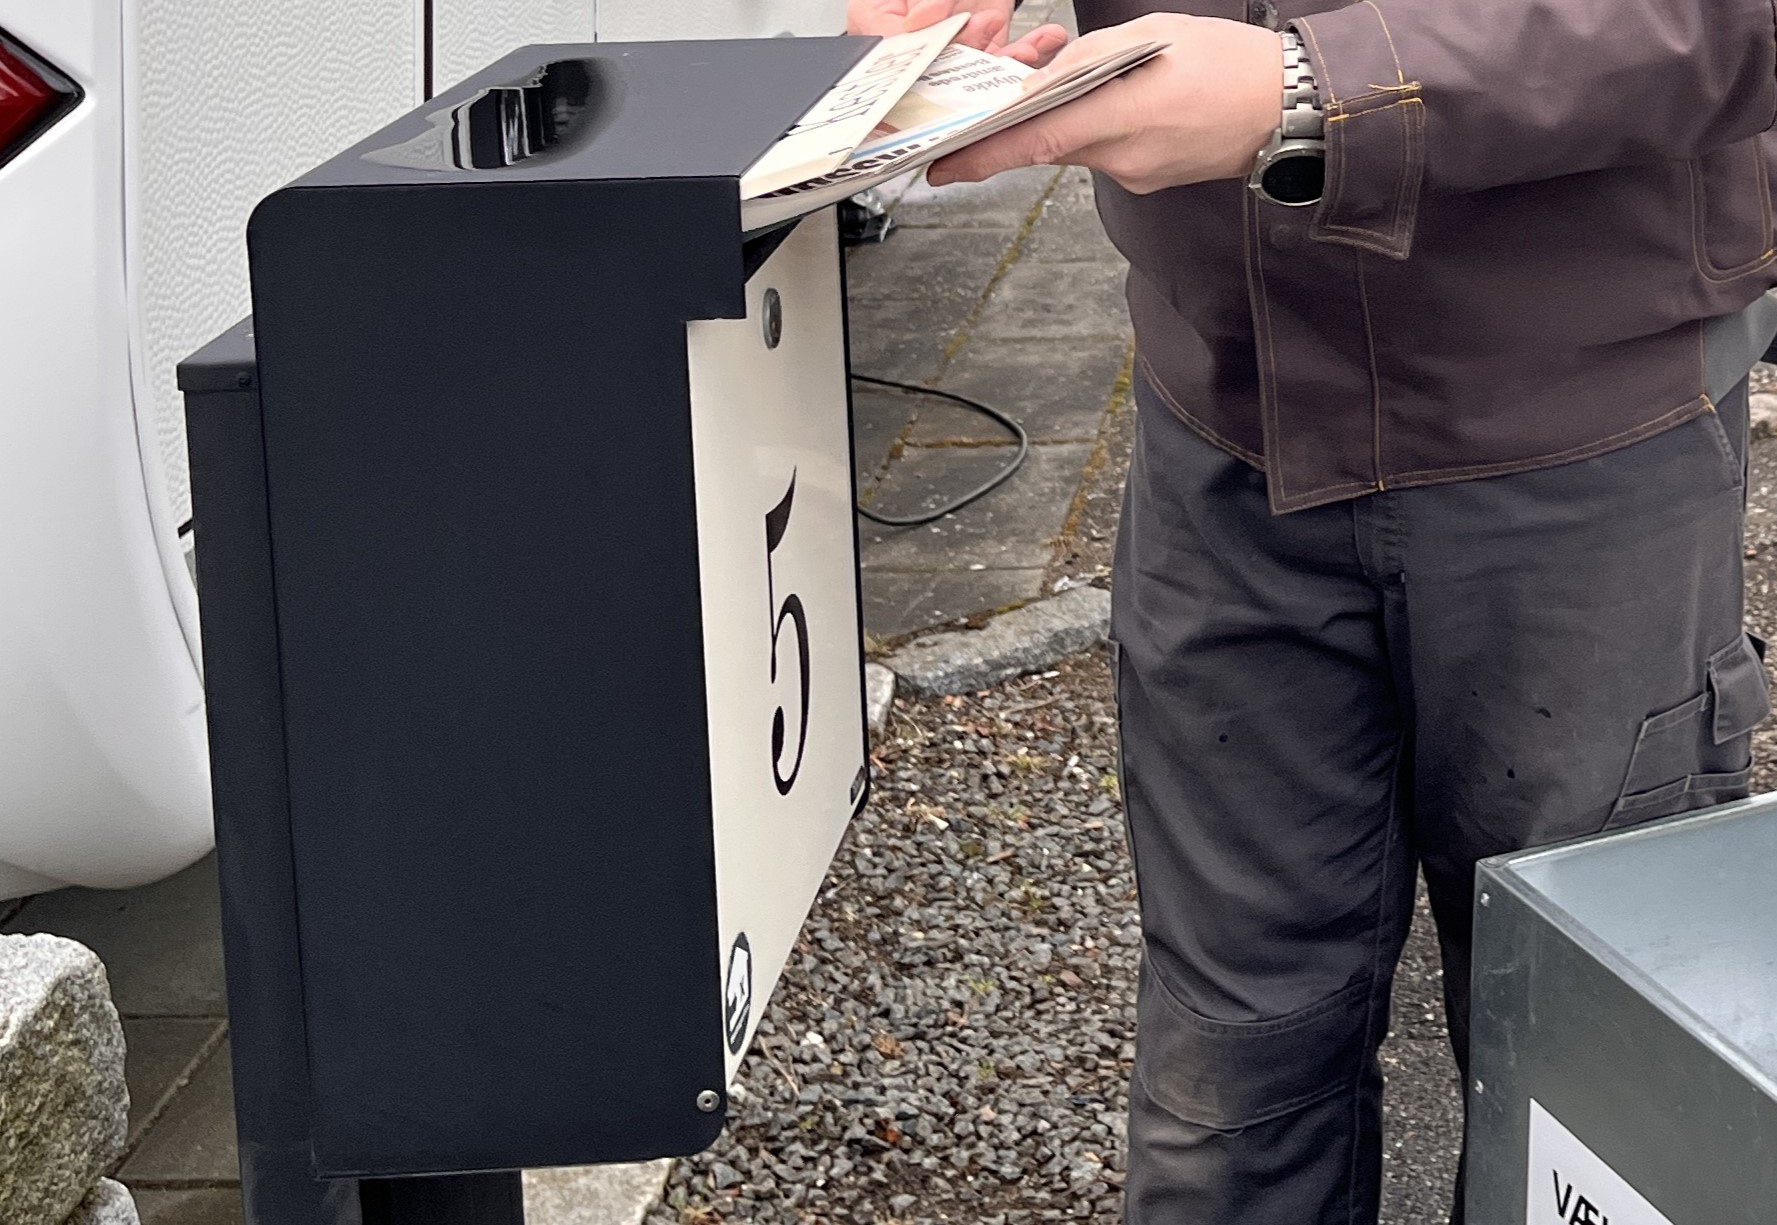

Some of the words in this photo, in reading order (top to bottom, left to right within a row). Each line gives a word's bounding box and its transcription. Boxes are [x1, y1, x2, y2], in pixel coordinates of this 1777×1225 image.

[962, 74, 1023, 93] Ulykke
[765, 465, 810, 796] 5
[1552, 1168, 1609, 1225] VÆ
